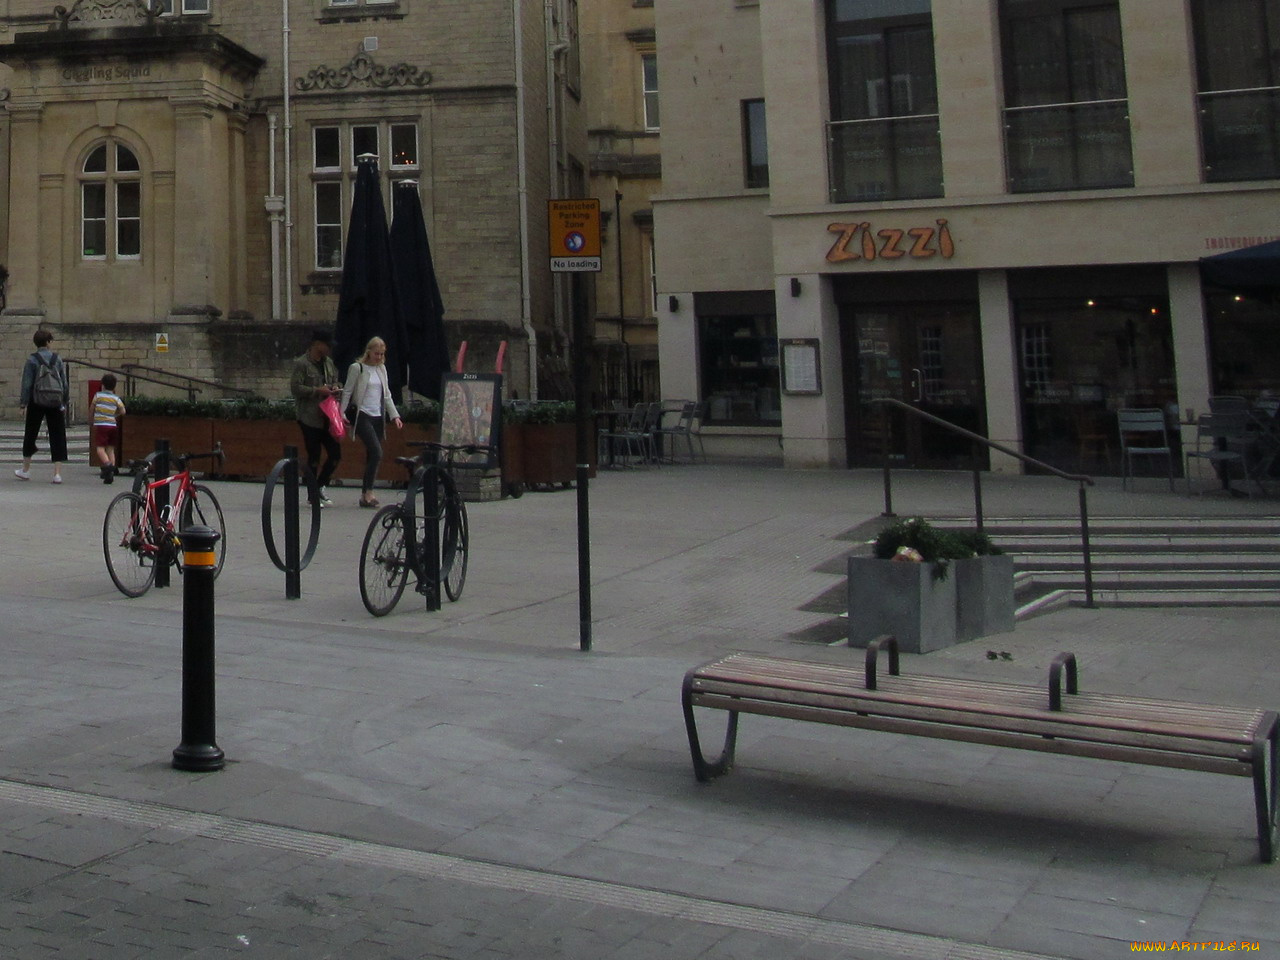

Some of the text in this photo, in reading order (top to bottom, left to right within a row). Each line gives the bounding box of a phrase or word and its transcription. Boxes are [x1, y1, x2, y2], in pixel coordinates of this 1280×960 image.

[62, 65, 150, 82] Giggling Squid
[553, 203, 595, 211] Restricted
[559, 211, 590, 220] Parking
[825, 218, 955, 263] Zizzi
[553, 259, 598, 269] No loading
